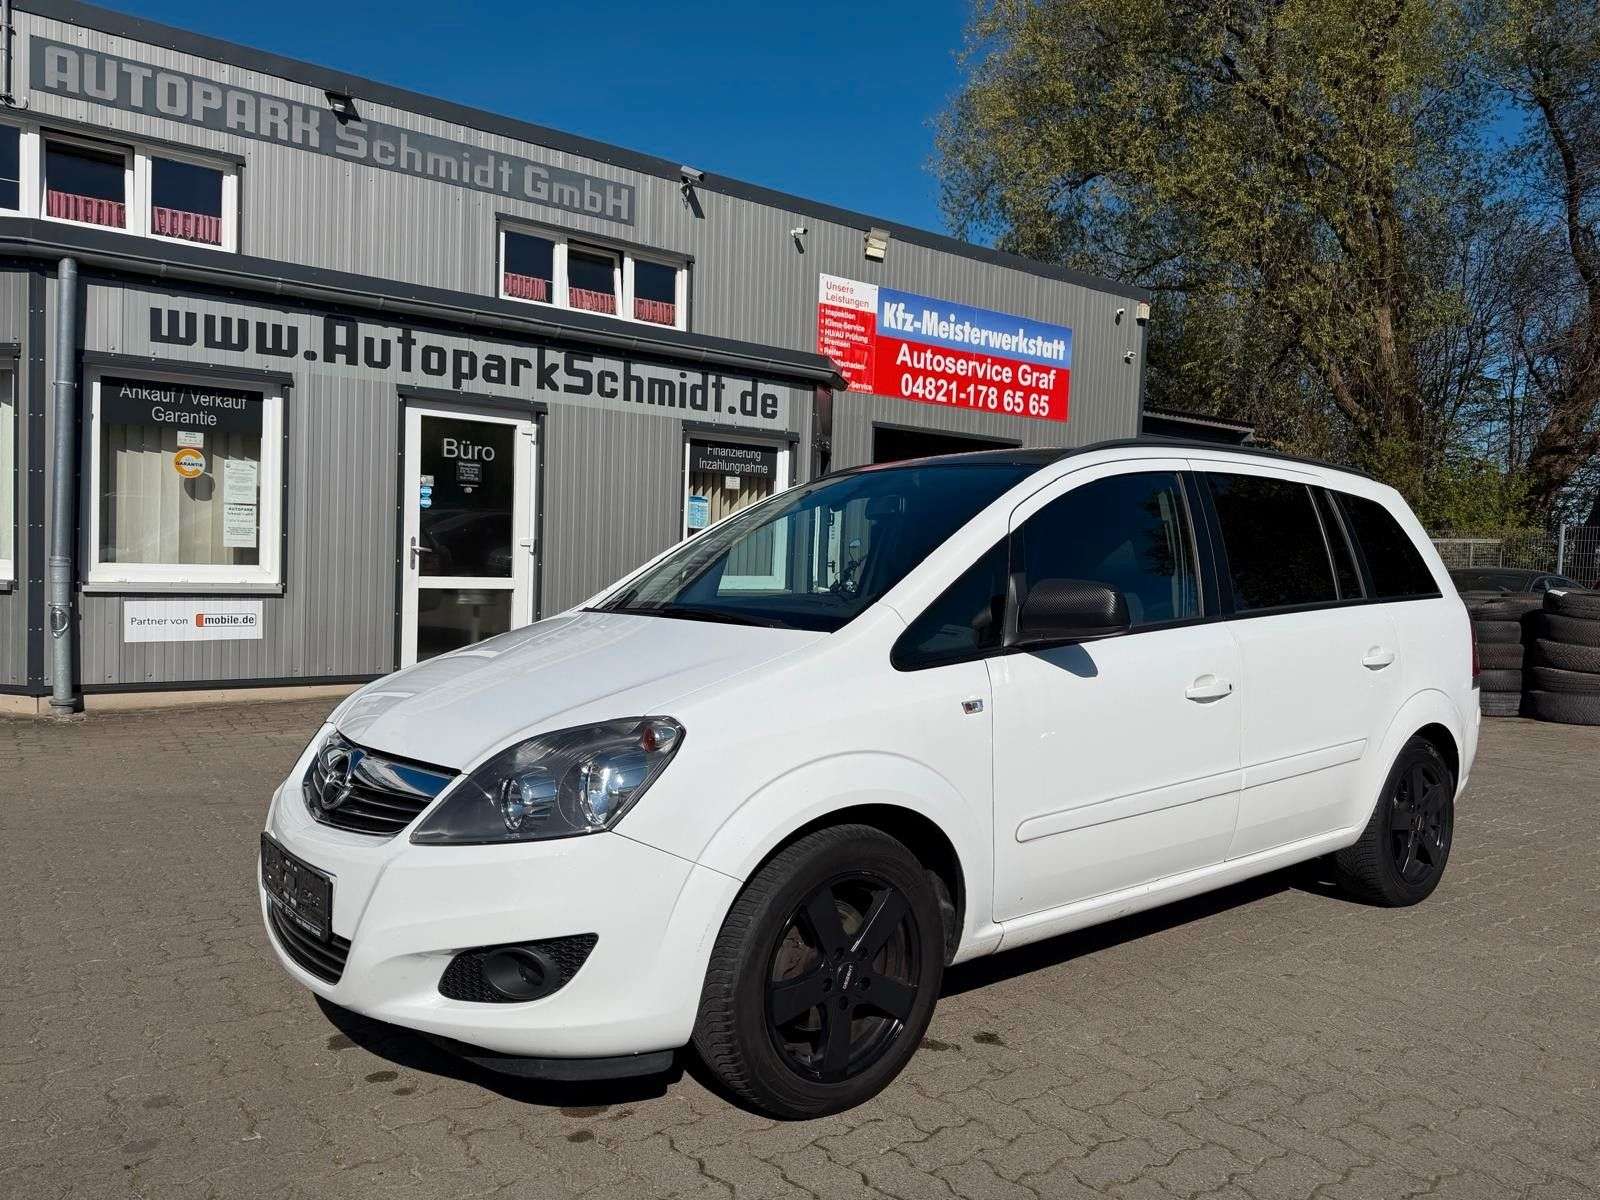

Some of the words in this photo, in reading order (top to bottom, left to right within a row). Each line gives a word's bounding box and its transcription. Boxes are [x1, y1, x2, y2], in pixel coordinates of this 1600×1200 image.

[45, 45, 320, 148] AUTOPARK
[336, 119, 513, 192] Schmidt
[524, 163, 629, 220] GmbH
[826, 281, 854, 294] Unsere
[826, 291, 870, 308] Leistungen
[883, 301, 1066, 361] Kfz-Meisterwerkstatt
[149, 306, 778, 420] www.AutoparkSchmidt.de
[896, 343, 1013, 384] Autoservice
[1017, 363, 1057, 390] Graf
[119, 384, 176, 402] Ankauf
[190, 391, 247, 410] Verkauf
[901, 373, 998, 409] 04821-178
[1003, 391, 1025, 413] 65
[1028, 393, 1050, 417] 65
[151, 406, 217, 426] Garantie
[443, 437, 496, 461] Büro
[707, 445, 762, 462] Finanzierung
[699, 457, 768, 474] Inzahlungnahme
[130, 617, 169, 626] Partner
[170, 617, 189, 625] von
[205, 615, 255, 625] mobile.de
